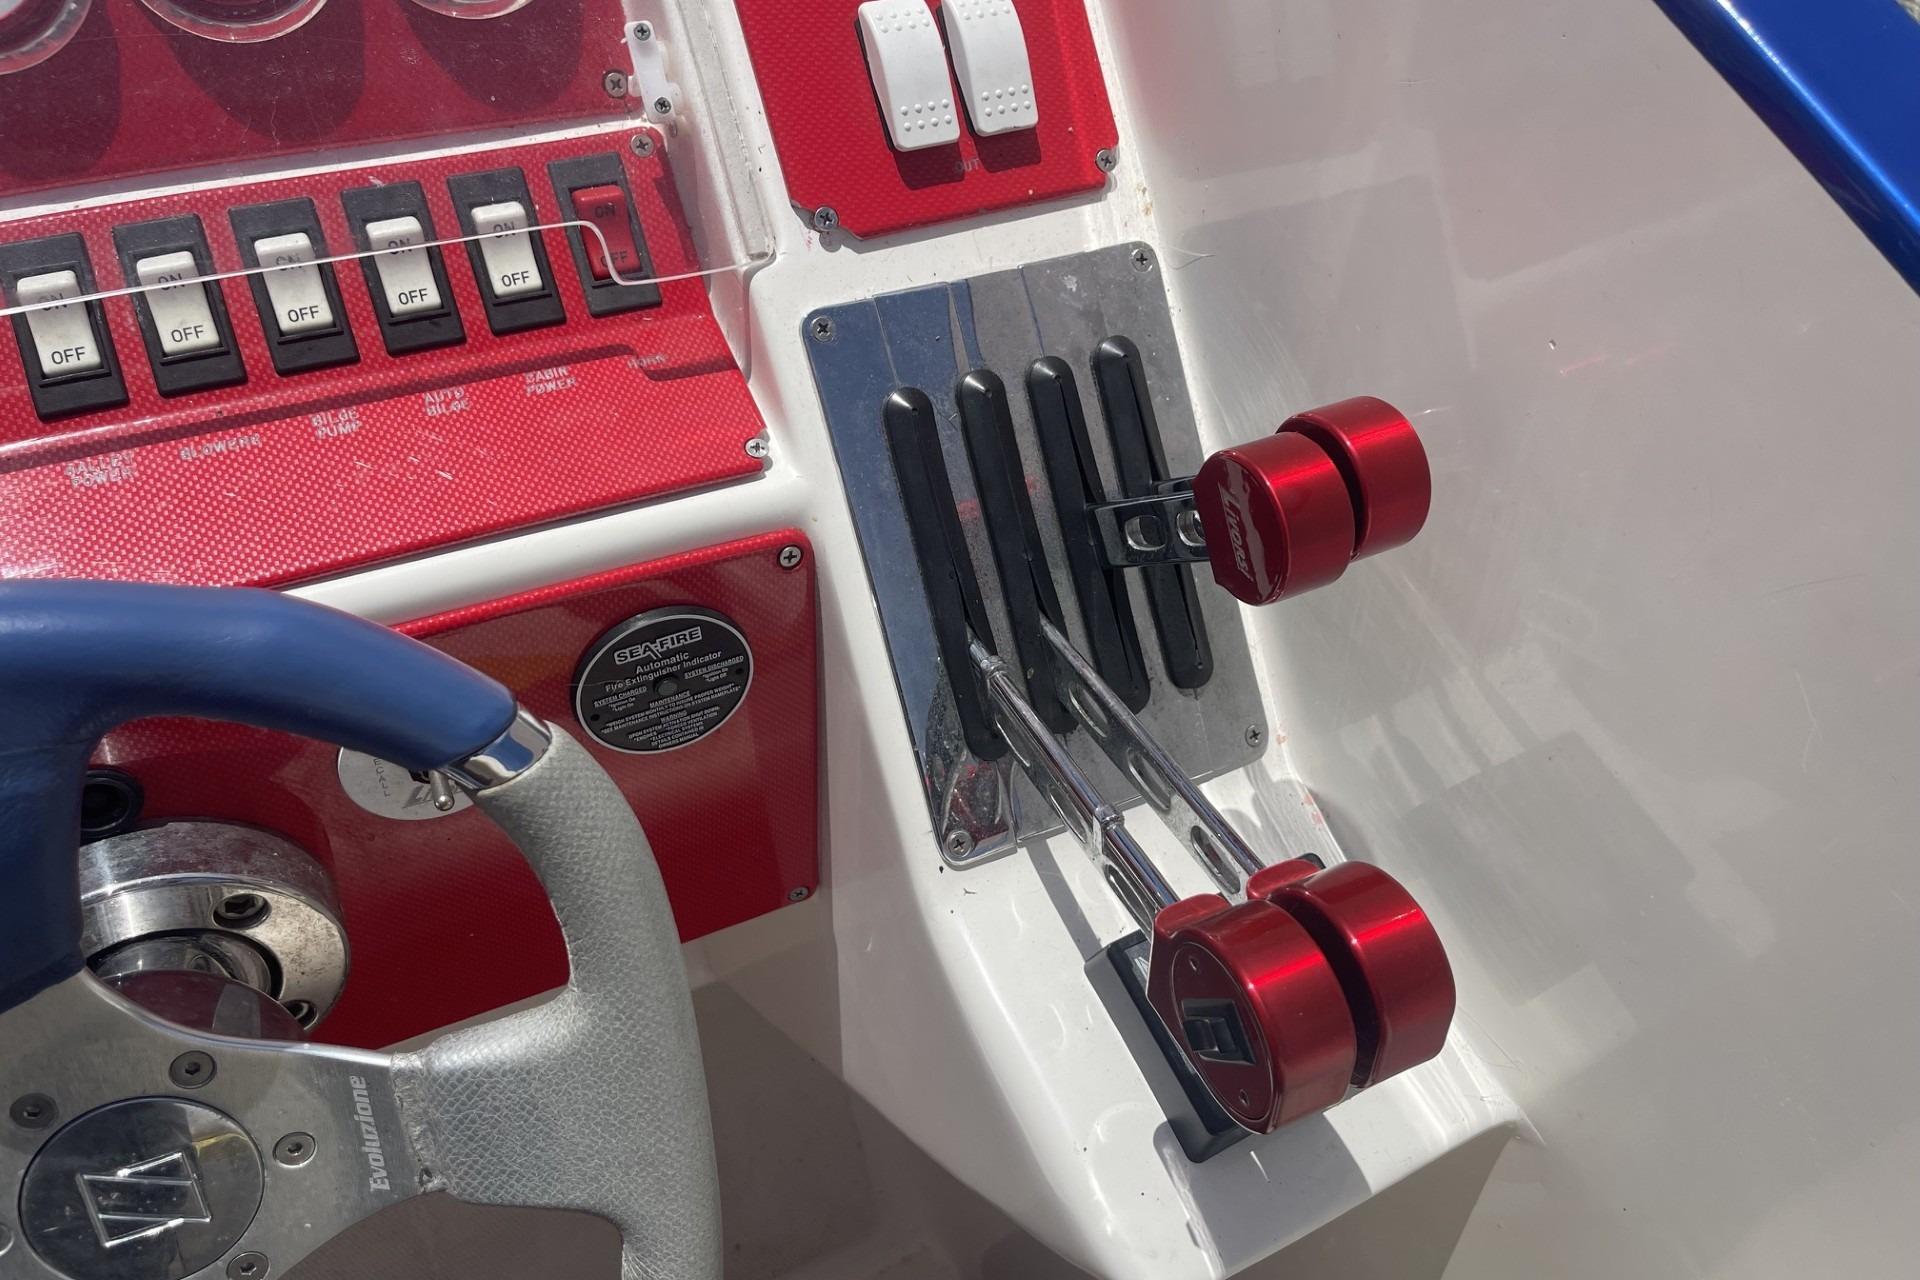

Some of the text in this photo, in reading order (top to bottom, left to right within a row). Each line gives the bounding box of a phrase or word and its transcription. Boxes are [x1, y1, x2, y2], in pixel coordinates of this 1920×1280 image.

[493, 221, 516, 239] ON
[388, 237, 413, 255] ON
[158, 272, 186, 291] ON
[501, 270, 530, 287] OFF
[398, 288, 428, 306] OFF
[287, 305, 320, 323] OFF
[171, 325, 204, 343] OFF
[50, 346, 85, 366] OFF
[526, 376, 576, 395] POWER
[606, 651, 722, 692] Fire Extinguisher Indicator
[635, 652, 690, 674] Automatic
[350, 1074, 391, 1193] Evoluzione
